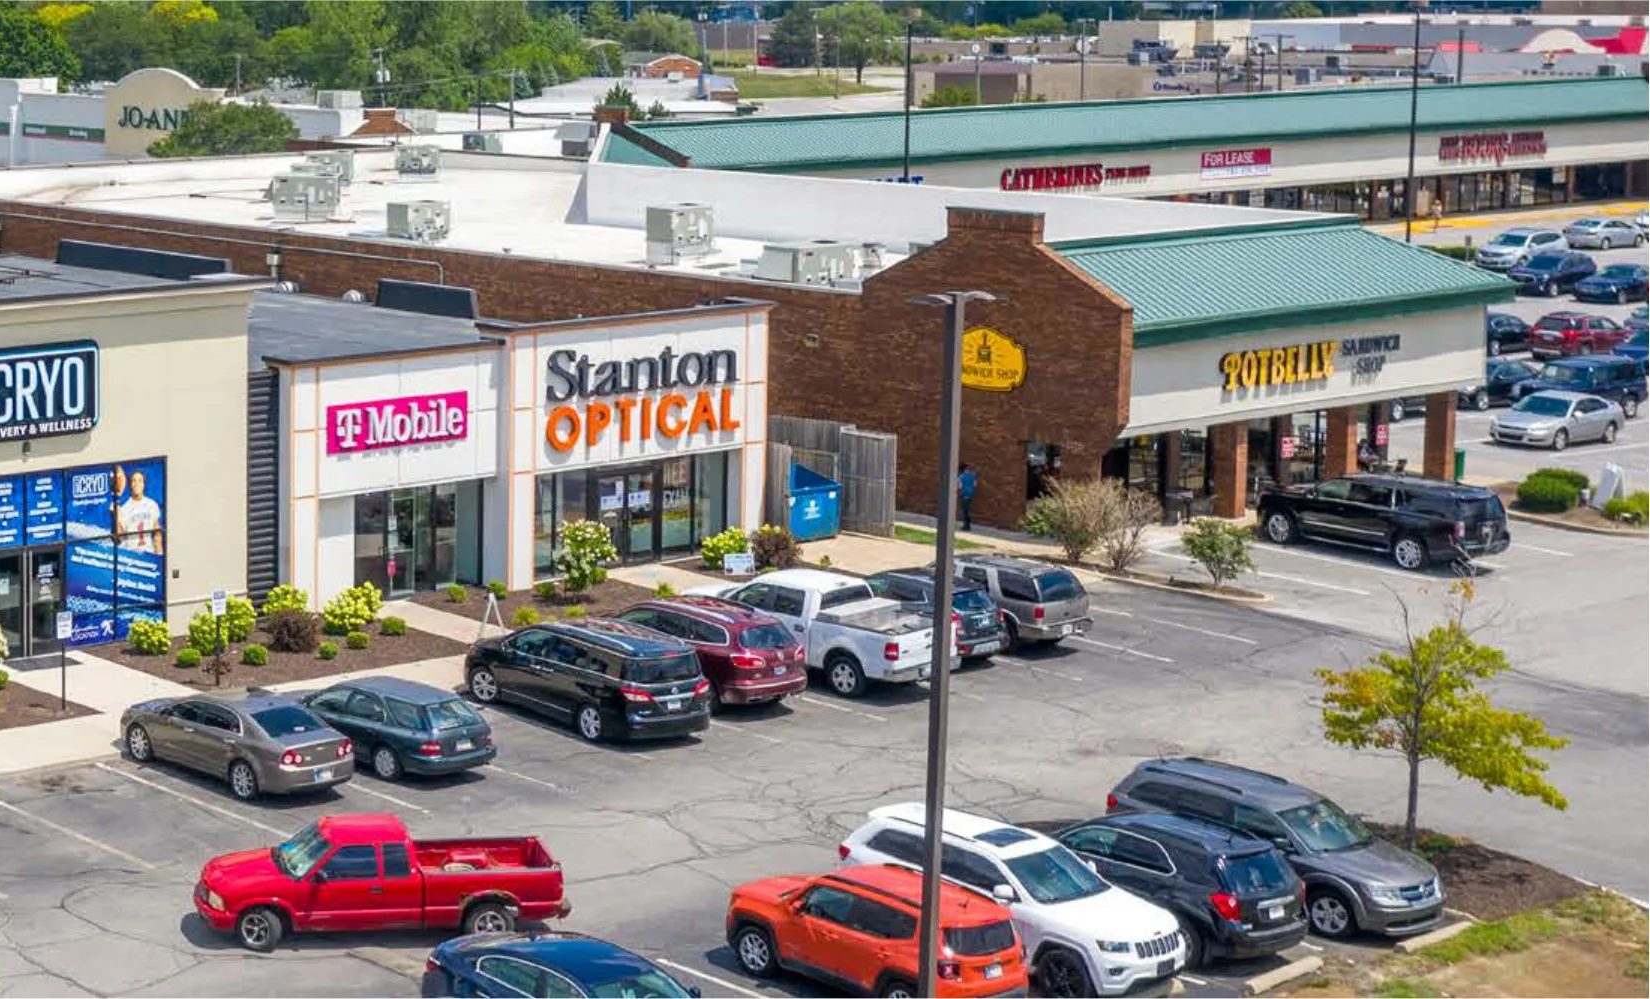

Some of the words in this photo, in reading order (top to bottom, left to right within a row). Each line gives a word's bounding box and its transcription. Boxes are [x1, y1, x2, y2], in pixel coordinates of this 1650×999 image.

[1001, 164, 1103, 190] CATHERINES
[546, 346, 738, 400] Stanton
[1219, 340, 1338, 391] POTBELLY
[1354, 355, 1386, 374] SHOP
[29, 422, 38, 435] &
[39, 418, 92, 433] WELLNESS
[546, 389, 740, 452] OPTICAL
